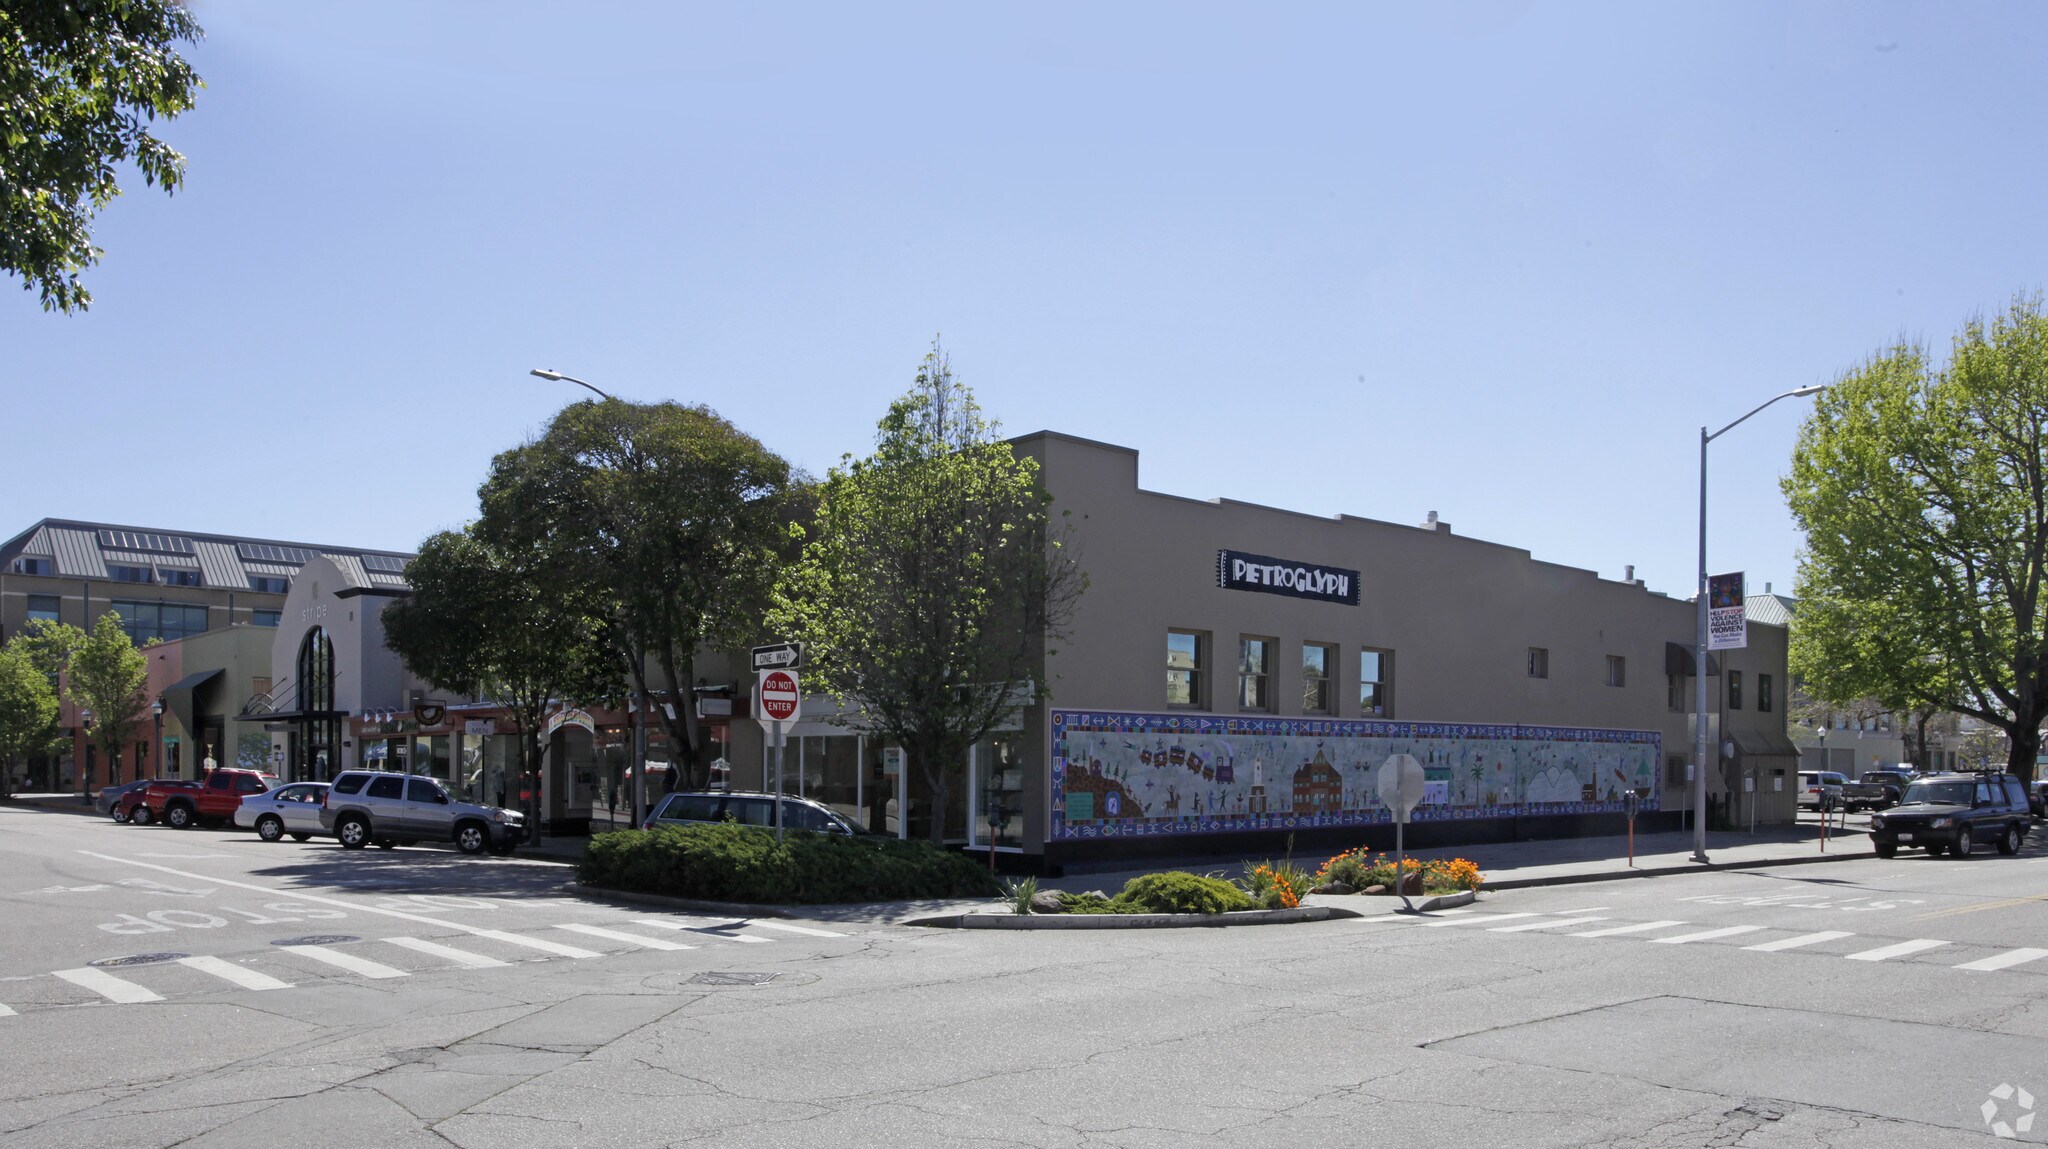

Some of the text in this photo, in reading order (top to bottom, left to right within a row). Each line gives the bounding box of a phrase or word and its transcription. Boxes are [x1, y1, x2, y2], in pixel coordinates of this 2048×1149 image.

[1232, 558, 1349, 597] PETROGLYPH
[302, 604, 327, 622] strpe
[1710, 625, 1742, 634] WOMEN
[759, 652, 791, 663] ONE WAY
[766, 680, 792, 689] DO NOT
[768, 702, 792, 711] ENTER
[97, 901, 349, 935] STOP
